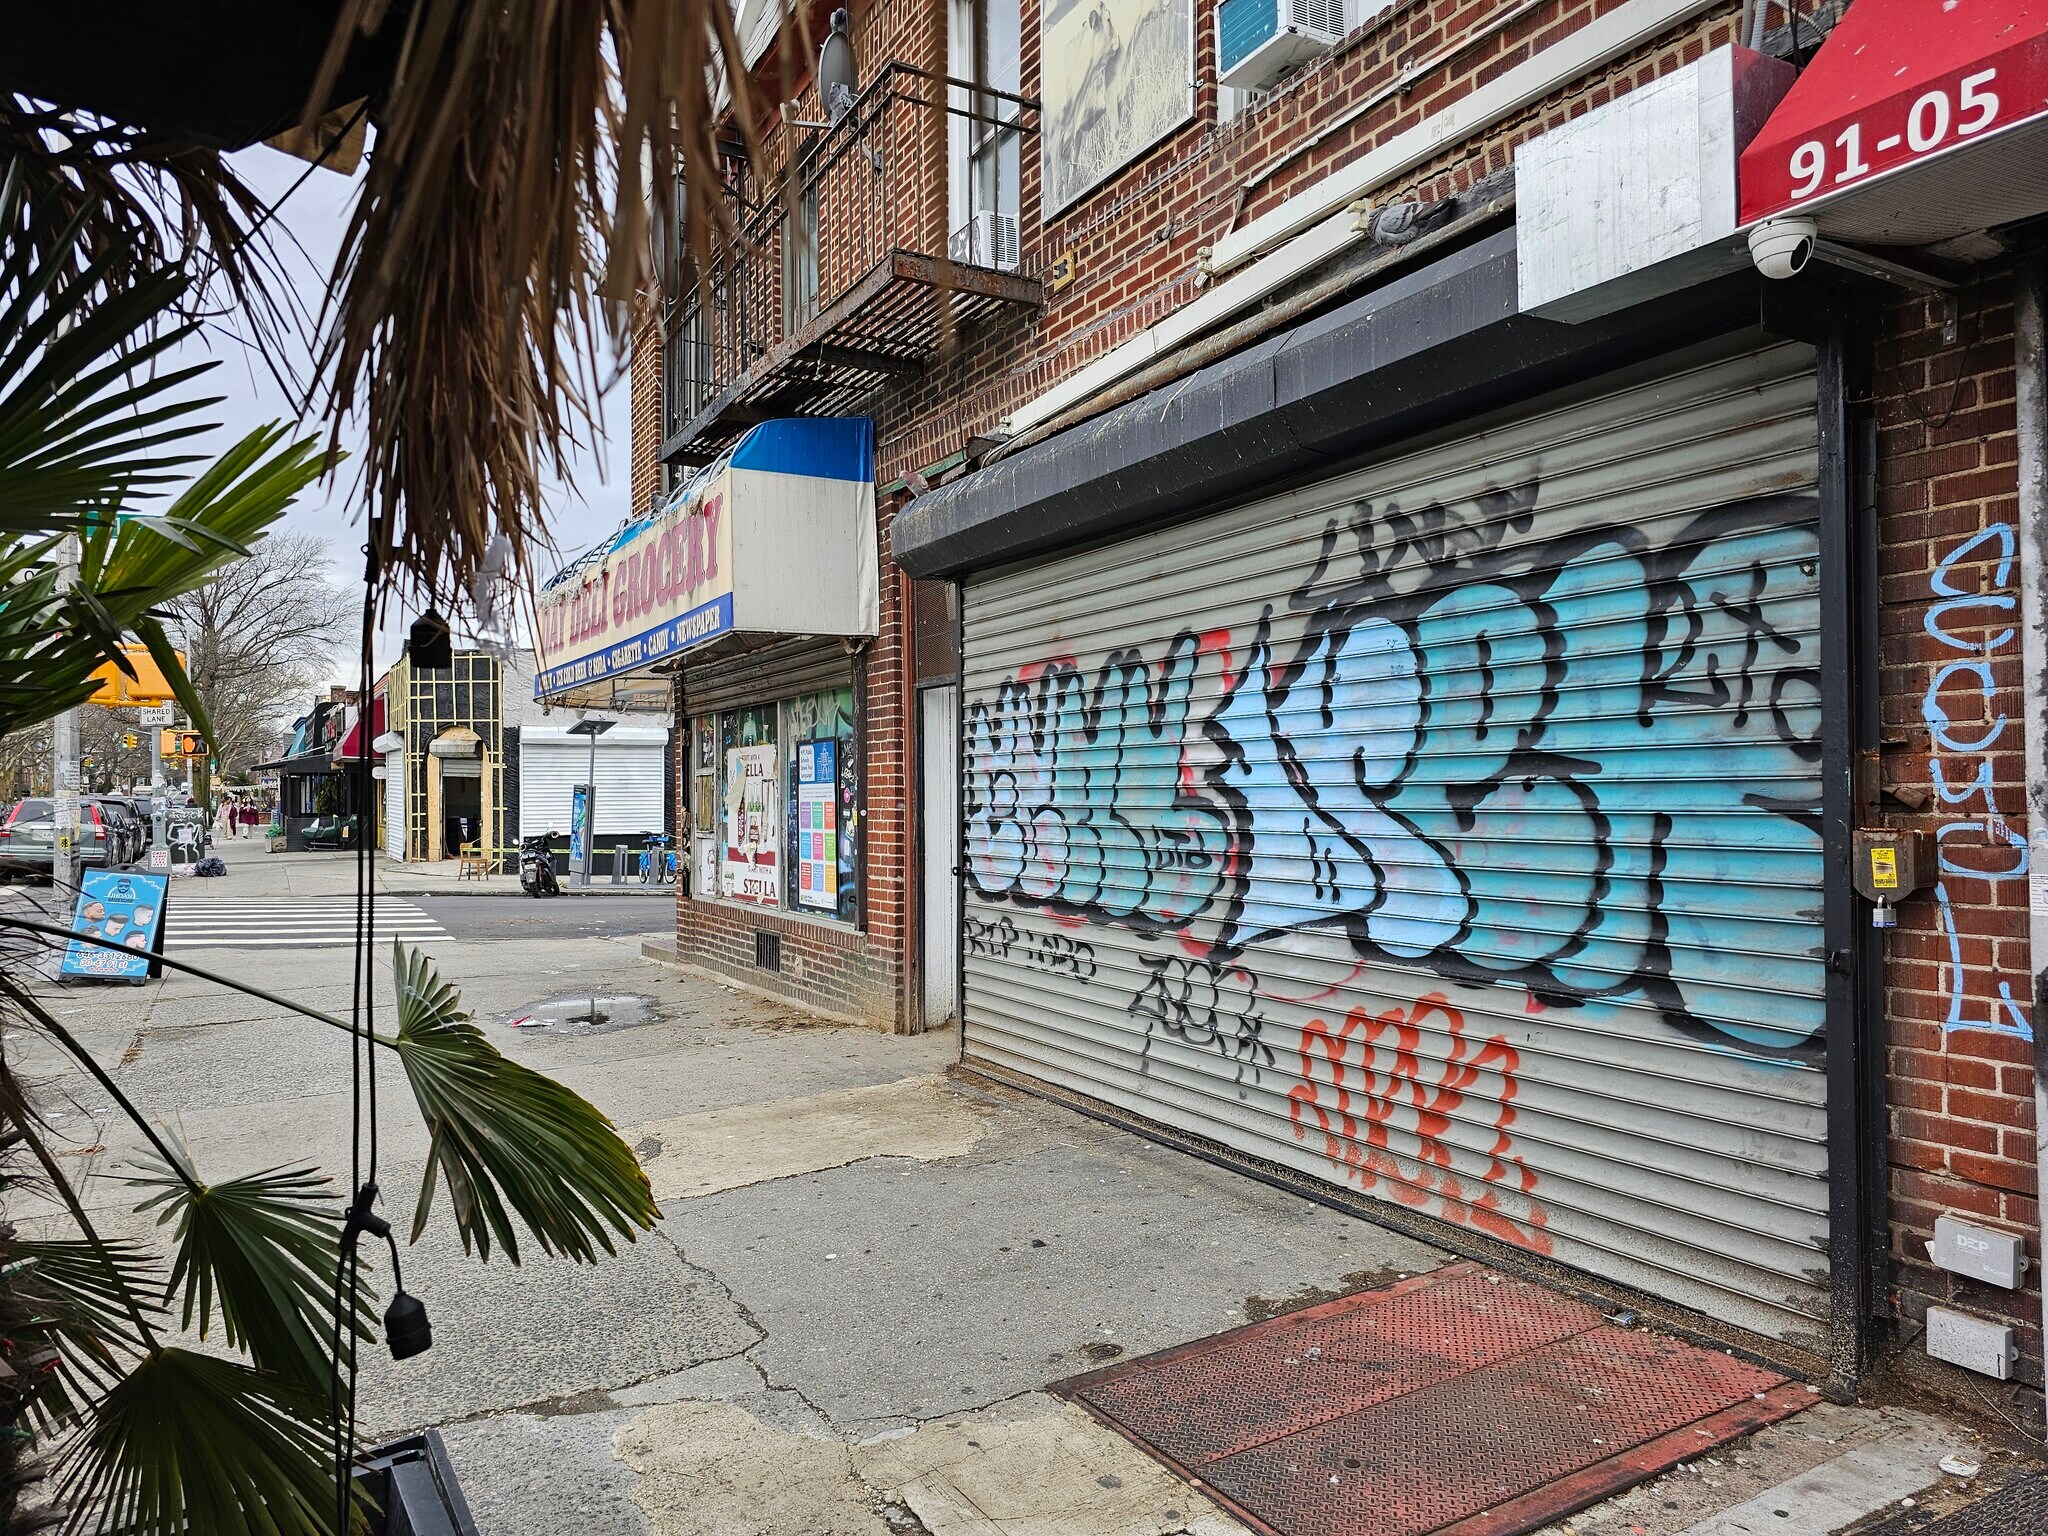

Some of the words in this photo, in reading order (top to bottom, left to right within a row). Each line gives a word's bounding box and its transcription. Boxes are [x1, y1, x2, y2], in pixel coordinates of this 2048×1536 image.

[1789, 68, 2000, 200] 91-05
[613, 493, 724, 629] GROCERY
[611, 640, 643, 669] CIGARETTE
[648, 628, 670, 656] CANDY
[676, 605, 720, 645] NEWSPAPER
[745, 763, 764, 778] ELLA
[748, 865, 758, 873] SART
[743, 878, 776, 897] STELLA
[1957, 1234, 1989, 1252] DEP
